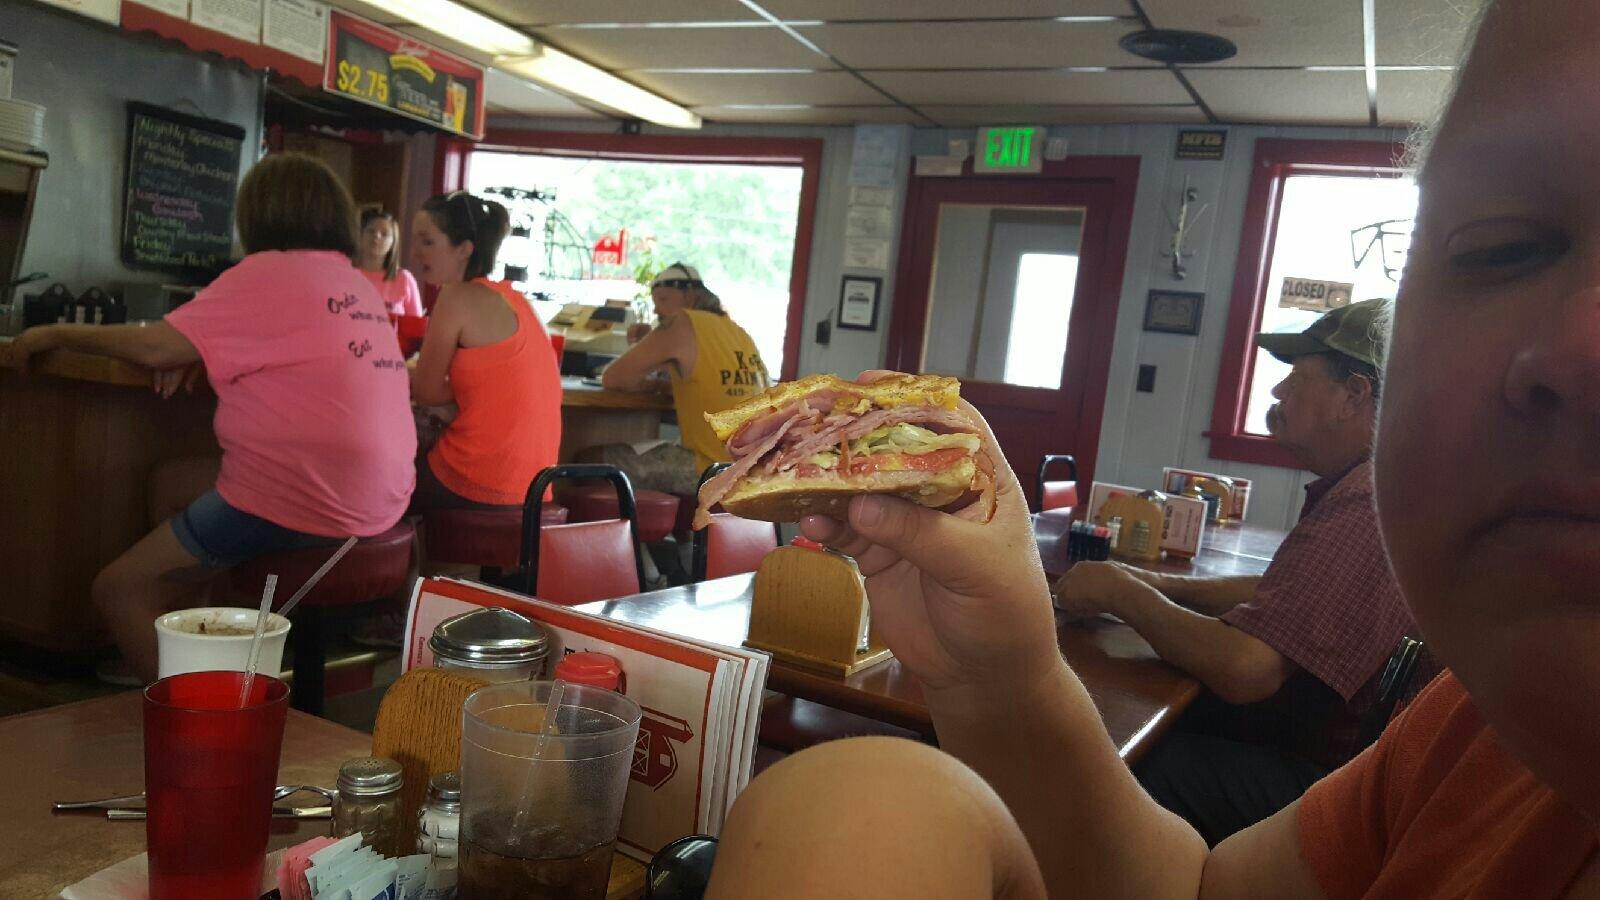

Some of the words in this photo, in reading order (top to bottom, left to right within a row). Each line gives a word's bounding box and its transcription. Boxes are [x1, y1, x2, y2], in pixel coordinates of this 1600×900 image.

[337, 59, 389, 105] $2.75
[984, 127, 1037, 167] EXIT
[1282, 280, 1326, 299] CLOSED
[372, 357, 394, 368] what
